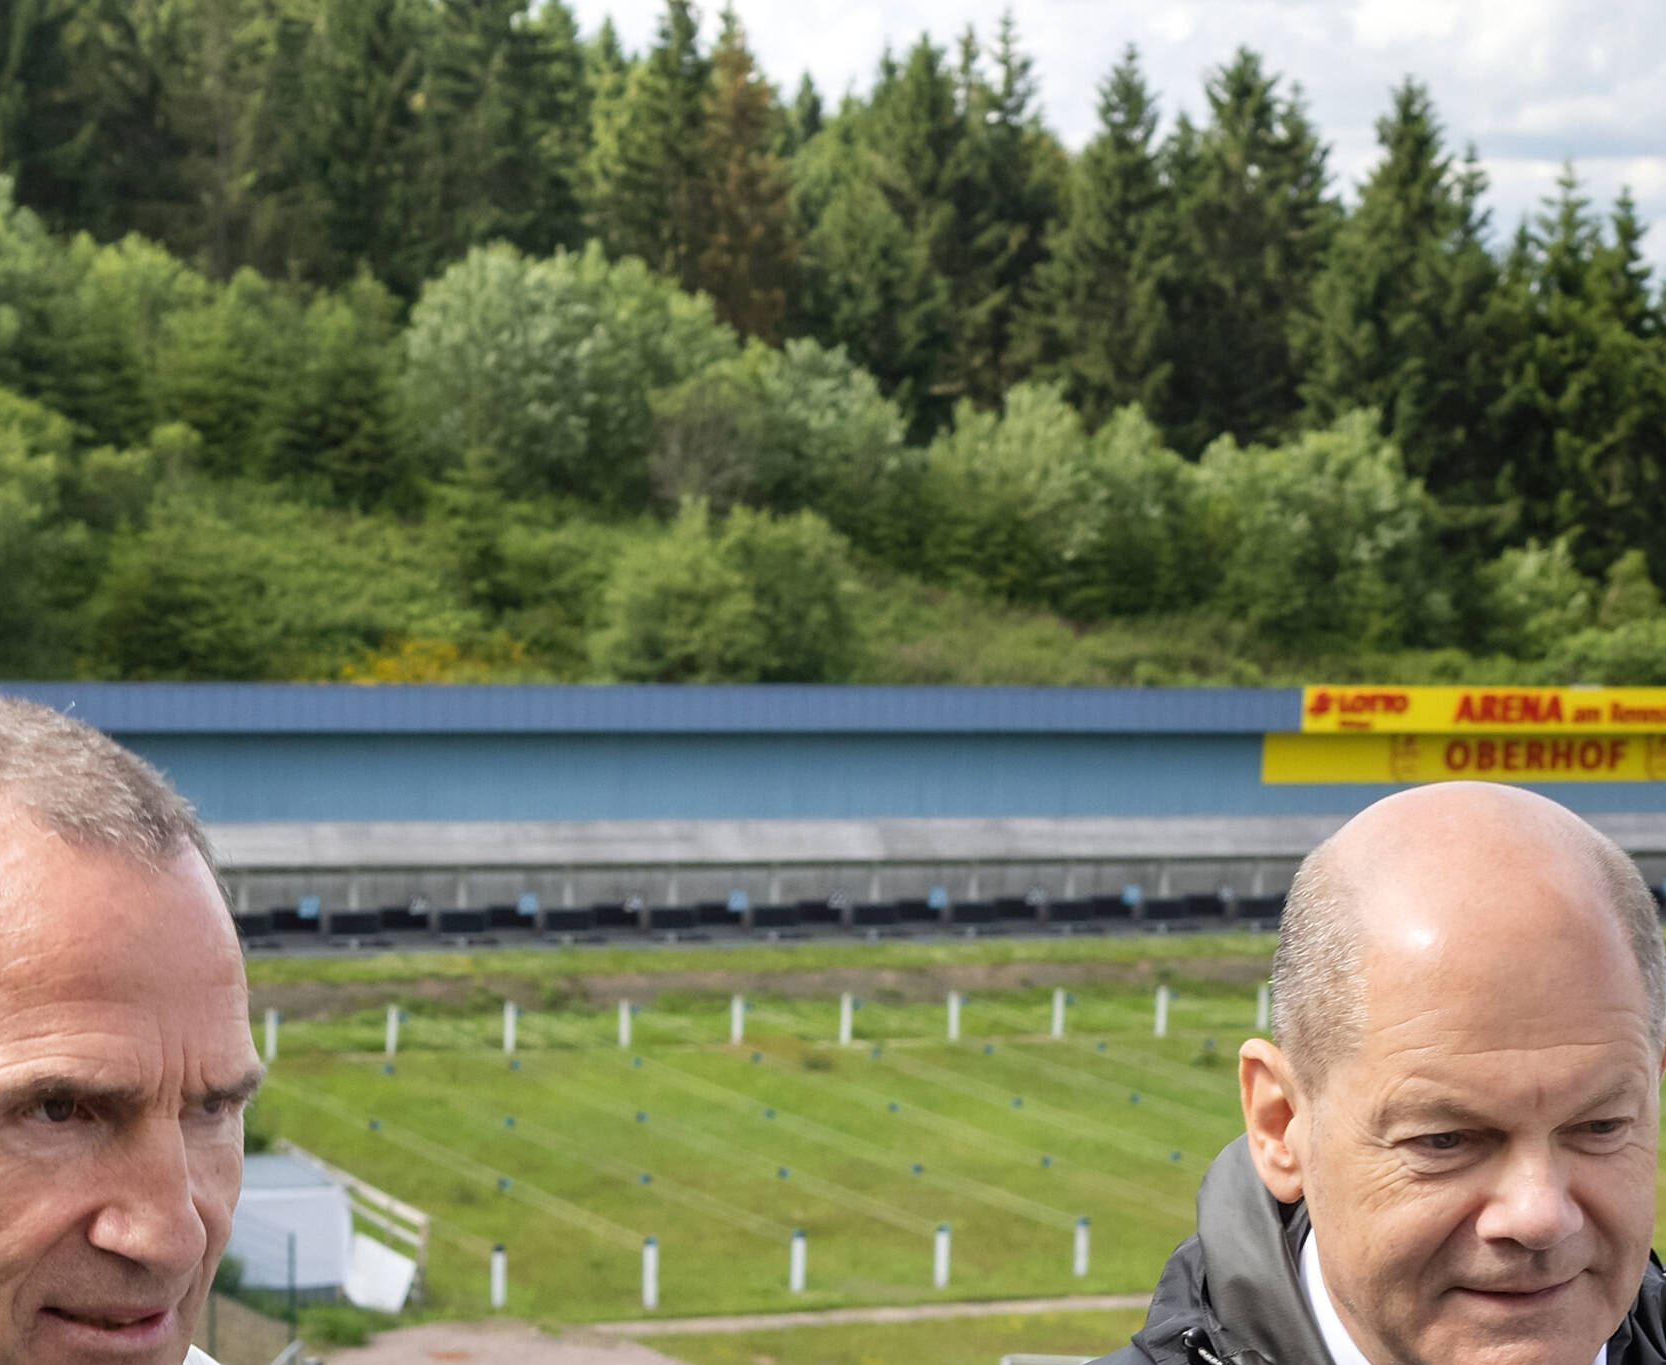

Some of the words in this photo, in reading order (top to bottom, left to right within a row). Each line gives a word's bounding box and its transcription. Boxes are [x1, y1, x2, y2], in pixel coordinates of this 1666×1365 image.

[1337, 693, 1409, 714] LOTTO
[1454, 693, 1563, 723] ARENA
[1444, 739, 1628, 772] OBERHOF
